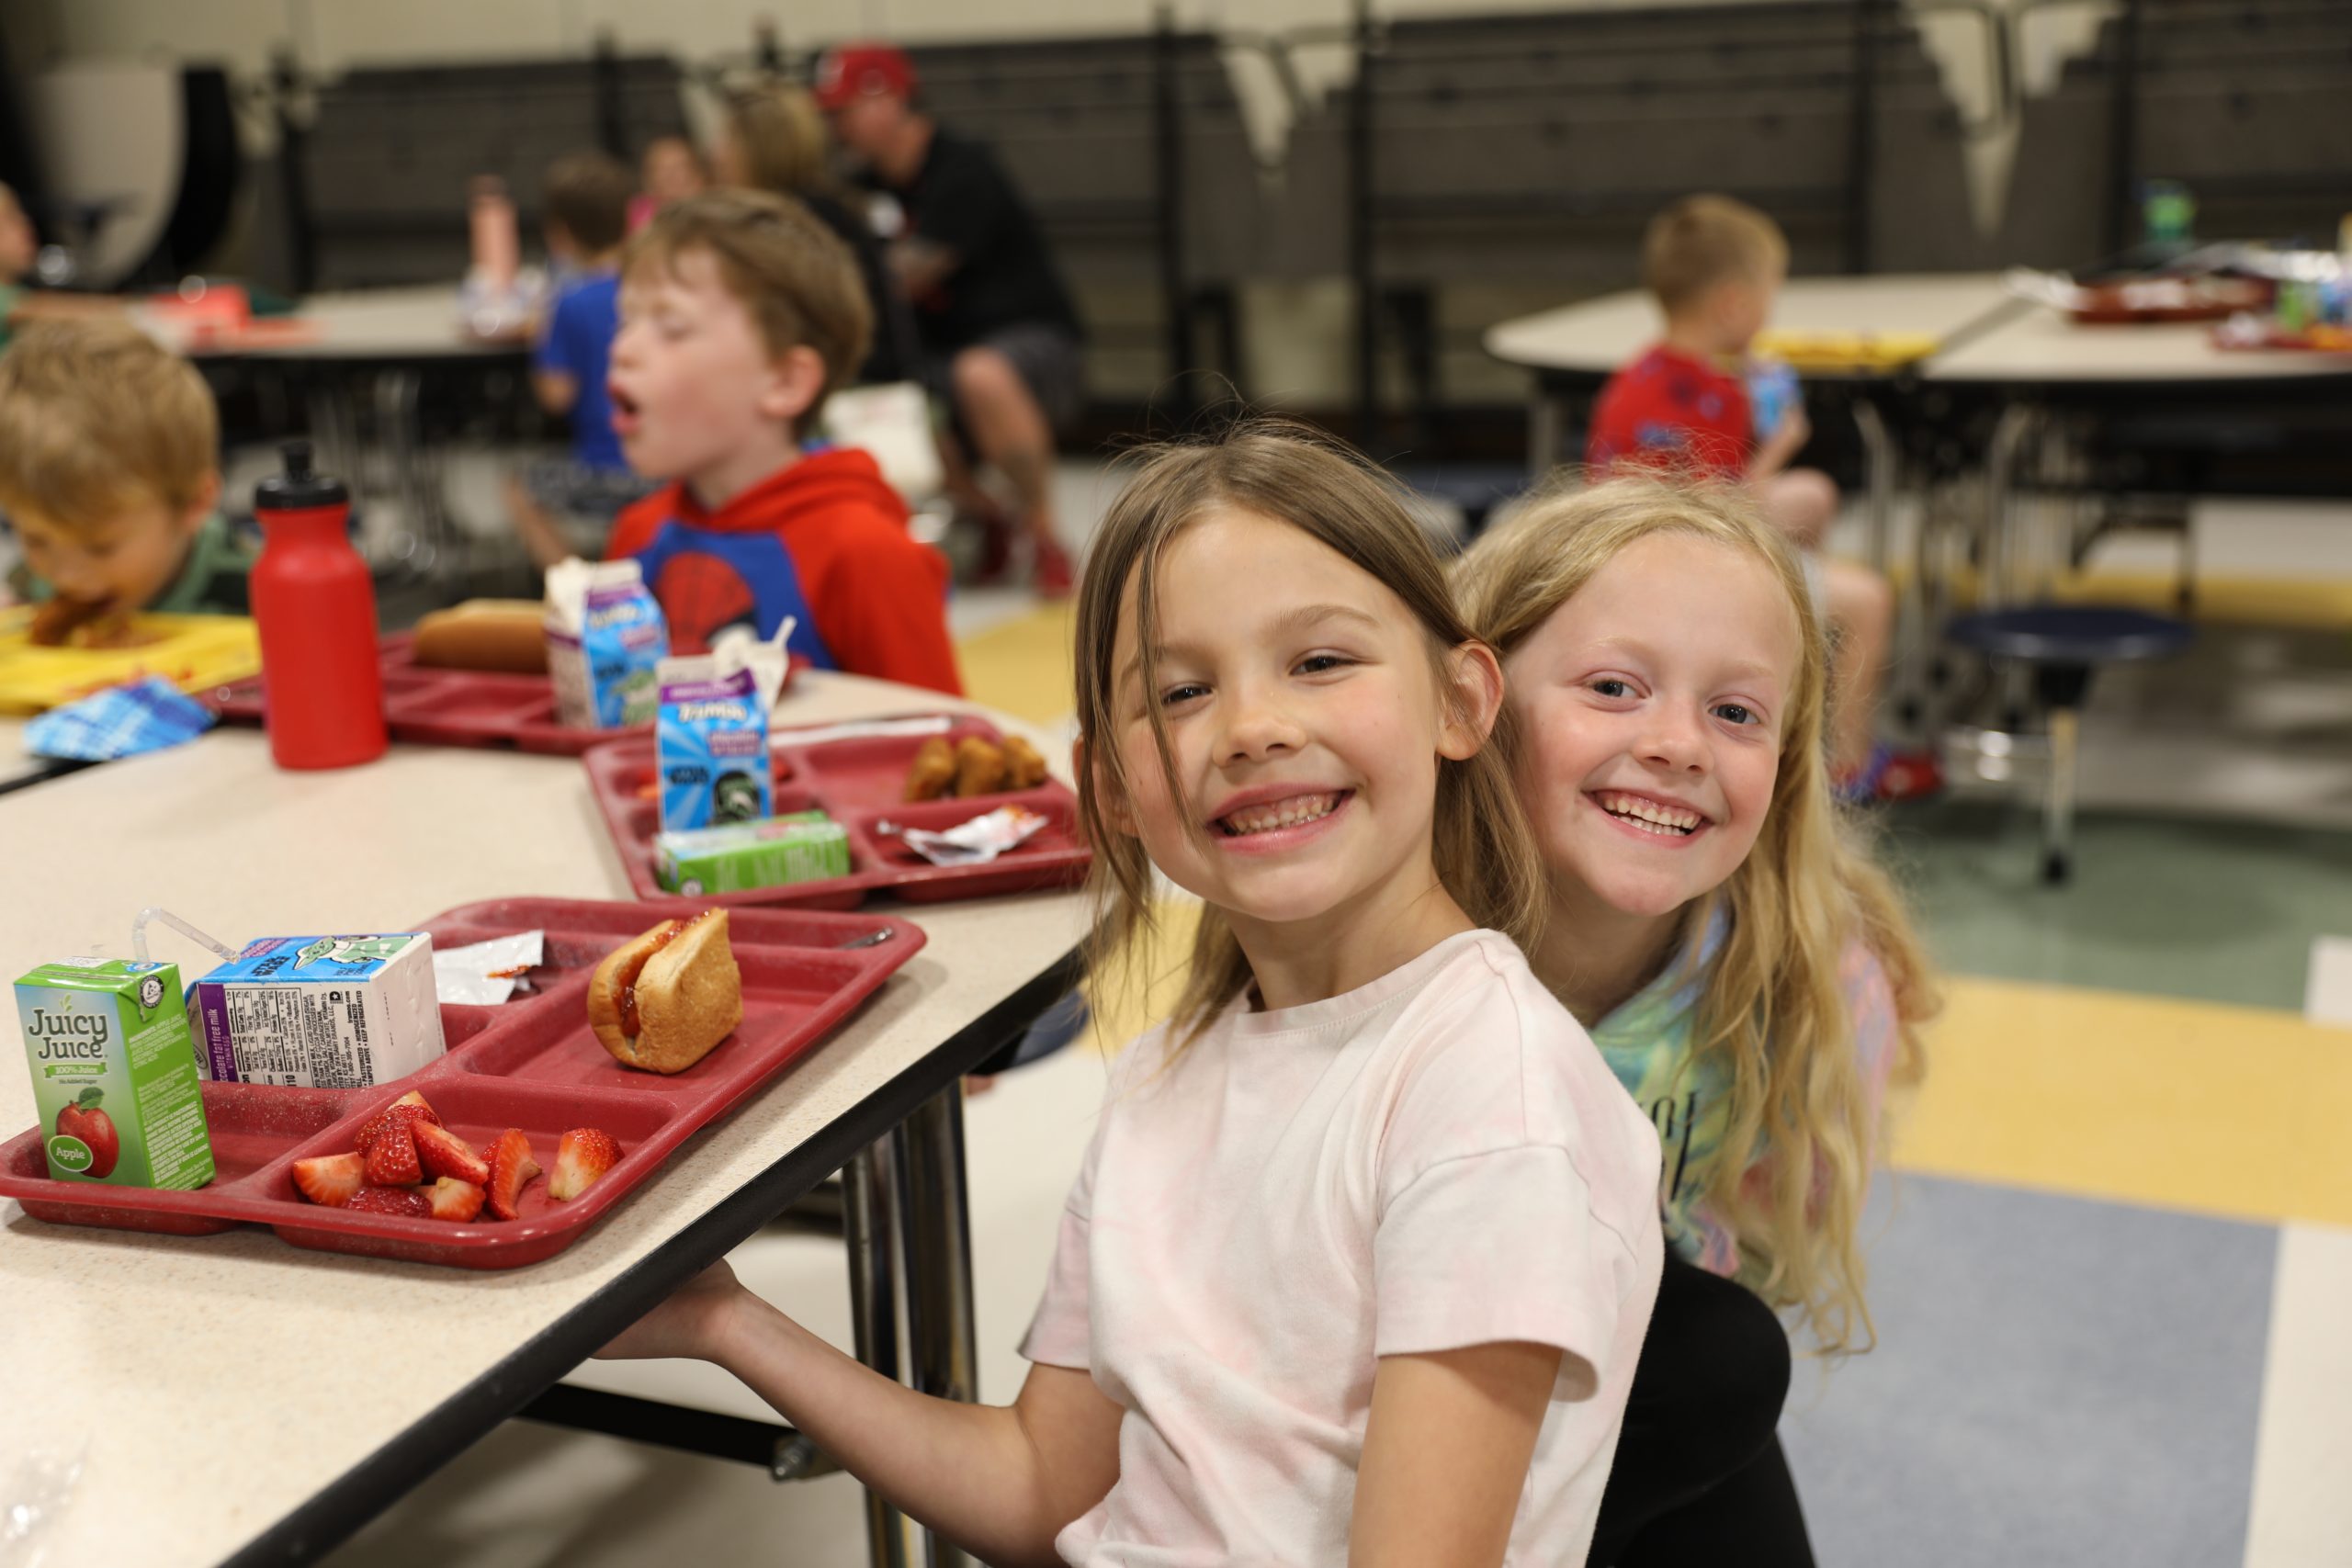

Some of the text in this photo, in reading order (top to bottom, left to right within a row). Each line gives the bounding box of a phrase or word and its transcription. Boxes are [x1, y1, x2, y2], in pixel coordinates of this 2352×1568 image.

[207, 1009, 220, 1025] milk
[322, 1001, 330, 1020] VITAMIN
[356, 990, 367, 1028] REFRIGERATED
[28, 1009, 108, 1044] Juicy
[209, 1026, 222, 1042] free
[38, 1036, 103, 1059] Juice
[352, 1004, 367, 1081] PASTEURIZED HOMOGENIZED
[56, 1066, 97, 1075] 100% Juice
[56, 1146, 85, 1160] Apple
